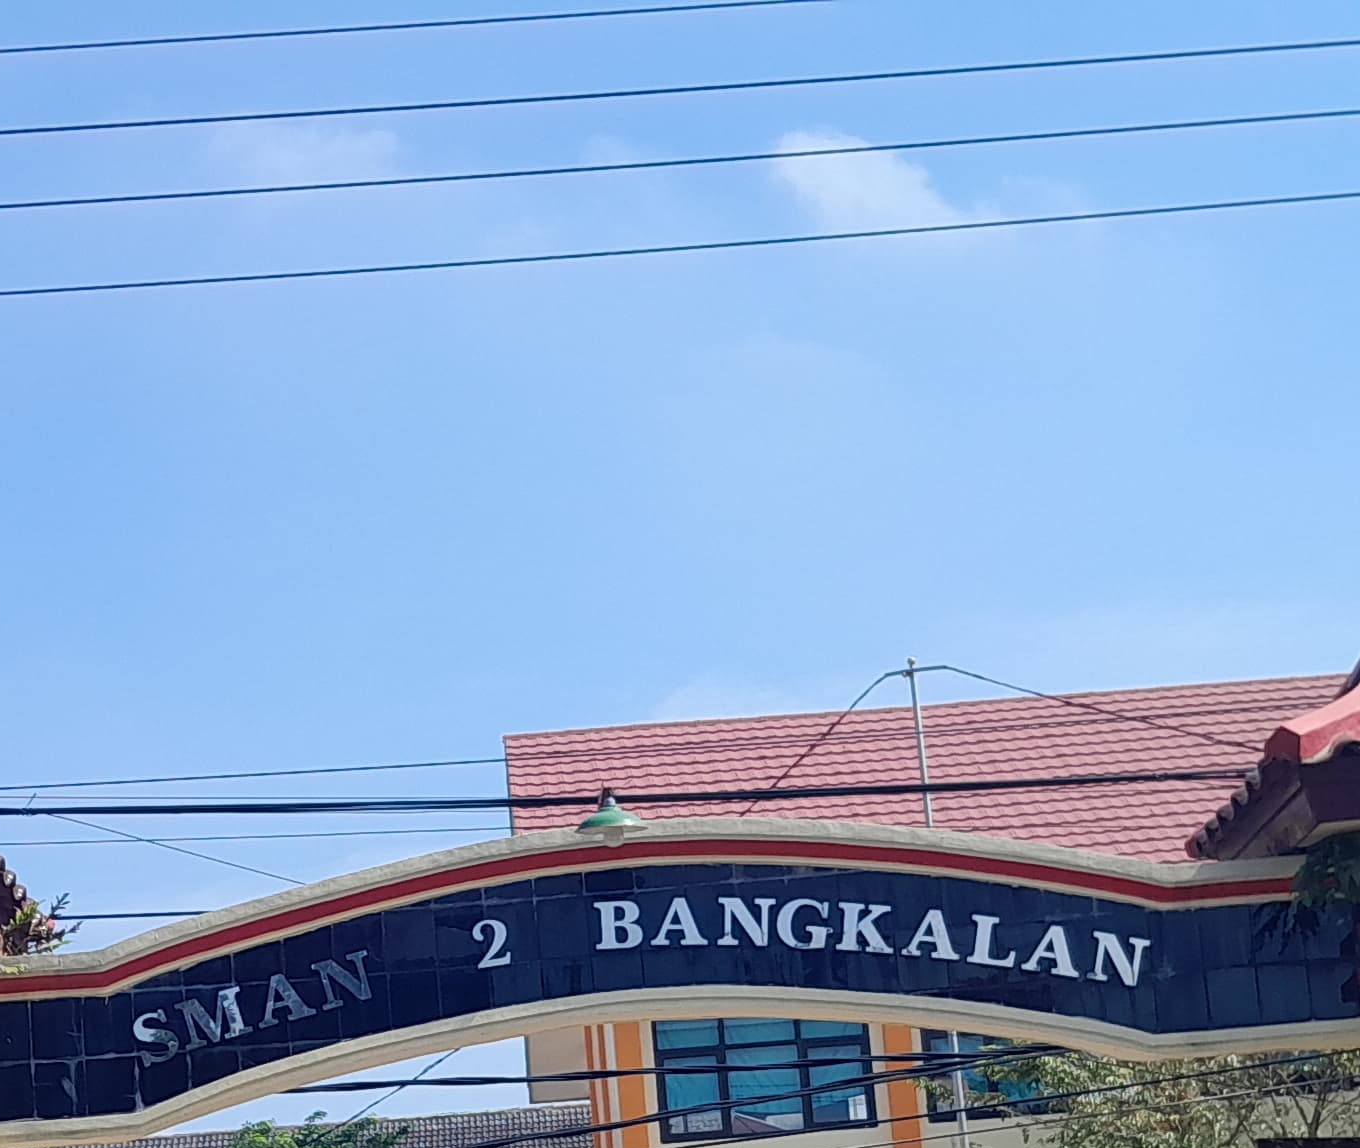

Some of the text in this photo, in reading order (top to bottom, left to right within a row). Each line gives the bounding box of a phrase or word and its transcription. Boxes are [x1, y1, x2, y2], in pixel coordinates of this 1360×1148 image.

[132, 896, 1151, 1067] SMAN 2 BANGKALAN
